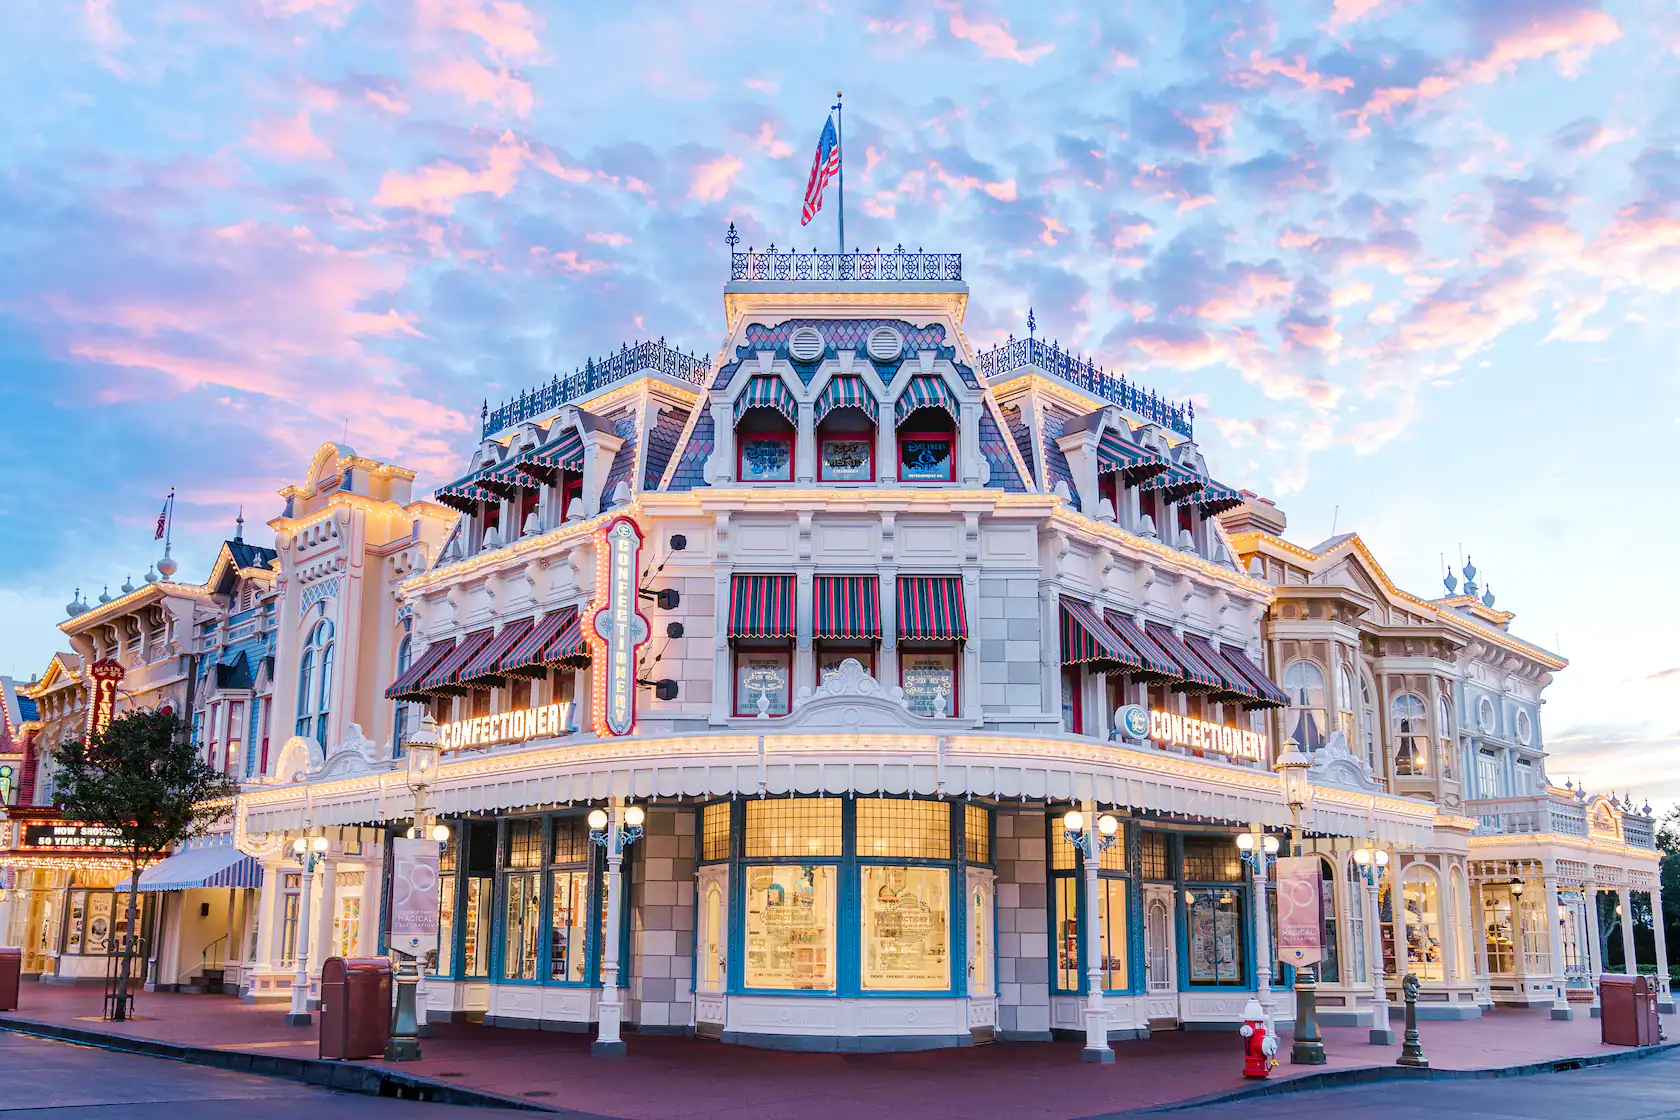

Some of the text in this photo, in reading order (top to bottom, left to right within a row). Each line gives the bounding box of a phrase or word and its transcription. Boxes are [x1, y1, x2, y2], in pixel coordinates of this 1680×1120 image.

[616, 539, 629, 722] CONFECTIONERY
[94, 666, 121, 674] MAIN
[441, 702, 571, 749] CONFECTIONERY
[1150, 709, 1267, 761] CONFECTIONERY
[38, 837, 52, 846] 50
[54, 837, 86, 846] YEARS
[89, 837, 102, 846] OF
[54, 827, 76, 836] NOW
